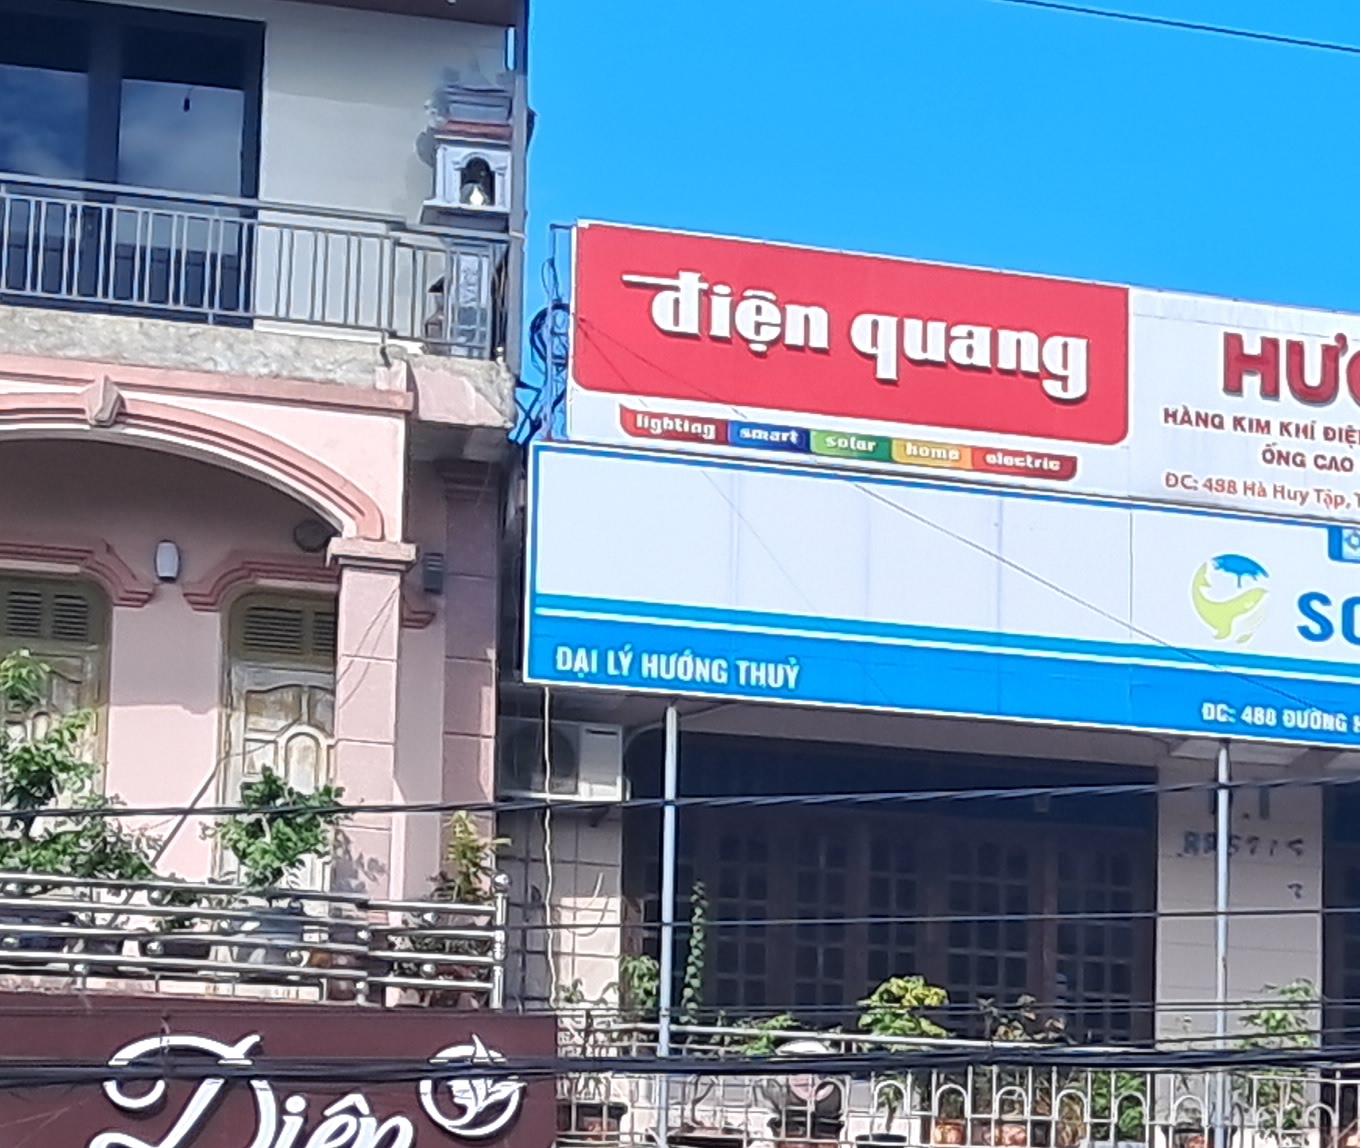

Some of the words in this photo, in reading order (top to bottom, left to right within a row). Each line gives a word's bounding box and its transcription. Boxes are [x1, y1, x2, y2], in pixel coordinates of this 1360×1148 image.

[621, 270, 830, 356] điện
[850, 311, 1090, 404] quang
[1163, 405, 1225, 431] HÀNG
[1233, 415, 1271, 435] KIM
[1279, 418, 1316, 441] KHÍ
[636, 412, 717, 441] lighting
[738, 424, 799, 447] smart
[824, 433, 878, 454] solar
[905, 440, 961, 462] home
[985, 450, 1062, 473] electric
[1261, 443, 1307, 469] ỐNG
[1314, 454, 1354, 473] CAO
[1165, 472, 1198, 491] ĐC:
[1243, 480, 1267, 498] Hà
[1273, 485, 1309, 506] Huy
[556, 646, 598, 678] ĐẠI
[607, 643, 633, 677] LÝ
[641, 649, 728, 684] HƯỚNG
[1202, 702, 1236, 723] ĐC:
[1283, 707, 1349, 733] ĐƯỜNG
